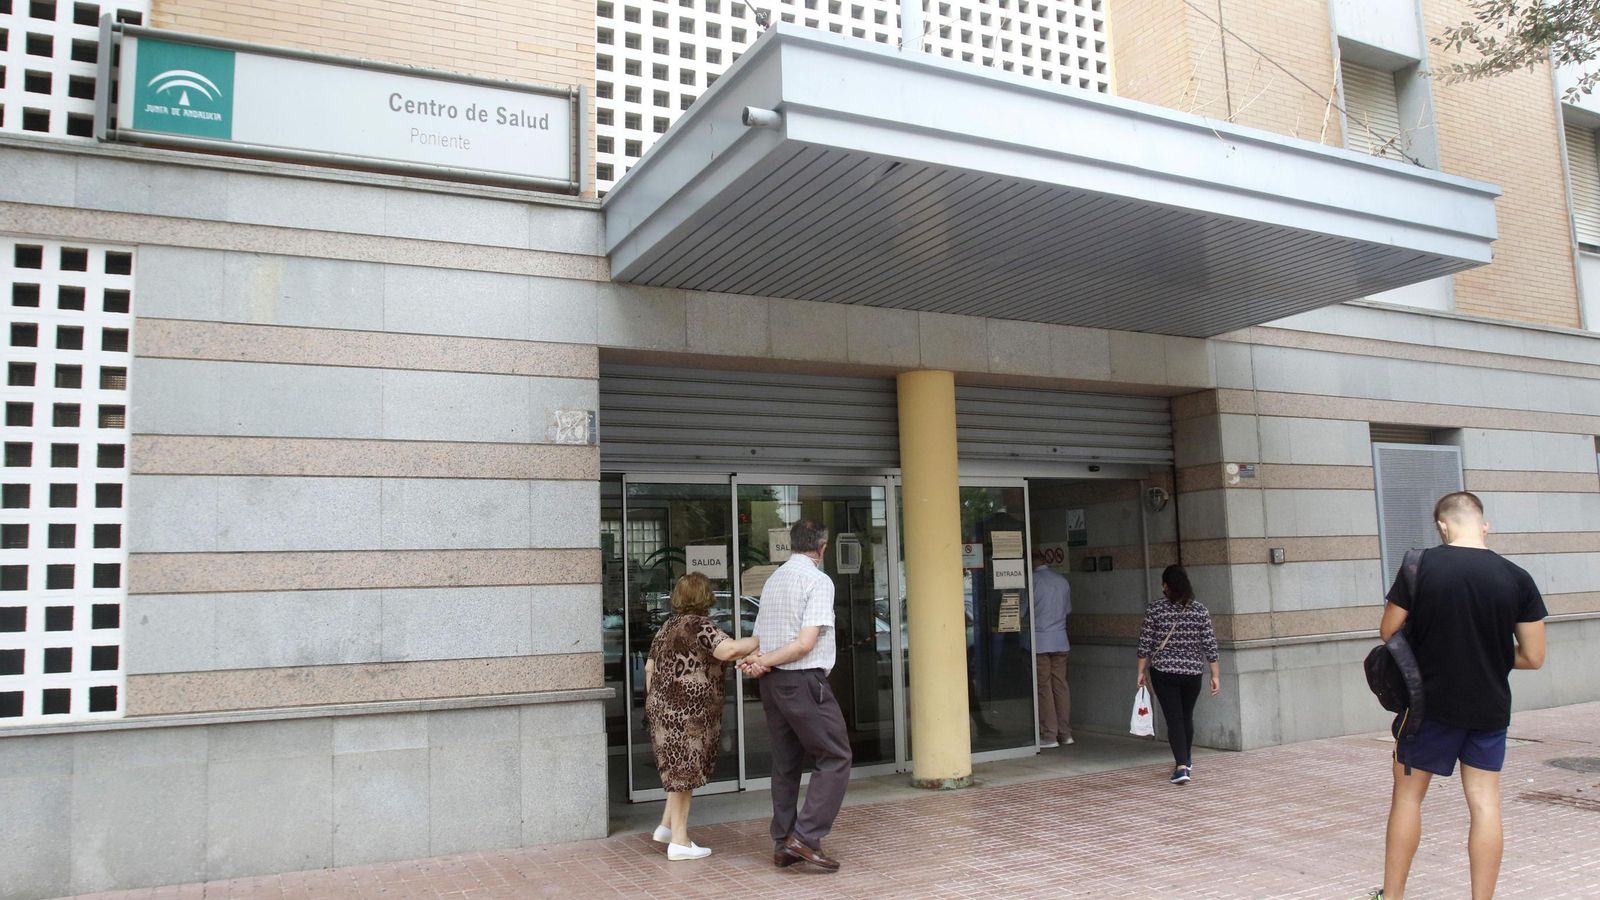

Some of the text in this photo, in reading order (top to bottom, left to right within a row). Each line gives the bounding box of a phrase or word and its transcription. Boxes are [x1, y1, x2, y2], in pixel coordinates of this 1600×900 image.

[144, 104, 169, 114] JUNTA
[171, 108, 181, 116] DE
[388, 92, 549, 130] Centro de Salud
[410, 127, 471, 150] Poniente
[775, 543, 790, 552] SAL
[691, 558, 721, 567] SALIDA
[995, 570, 1022, 578] ENTRADA
